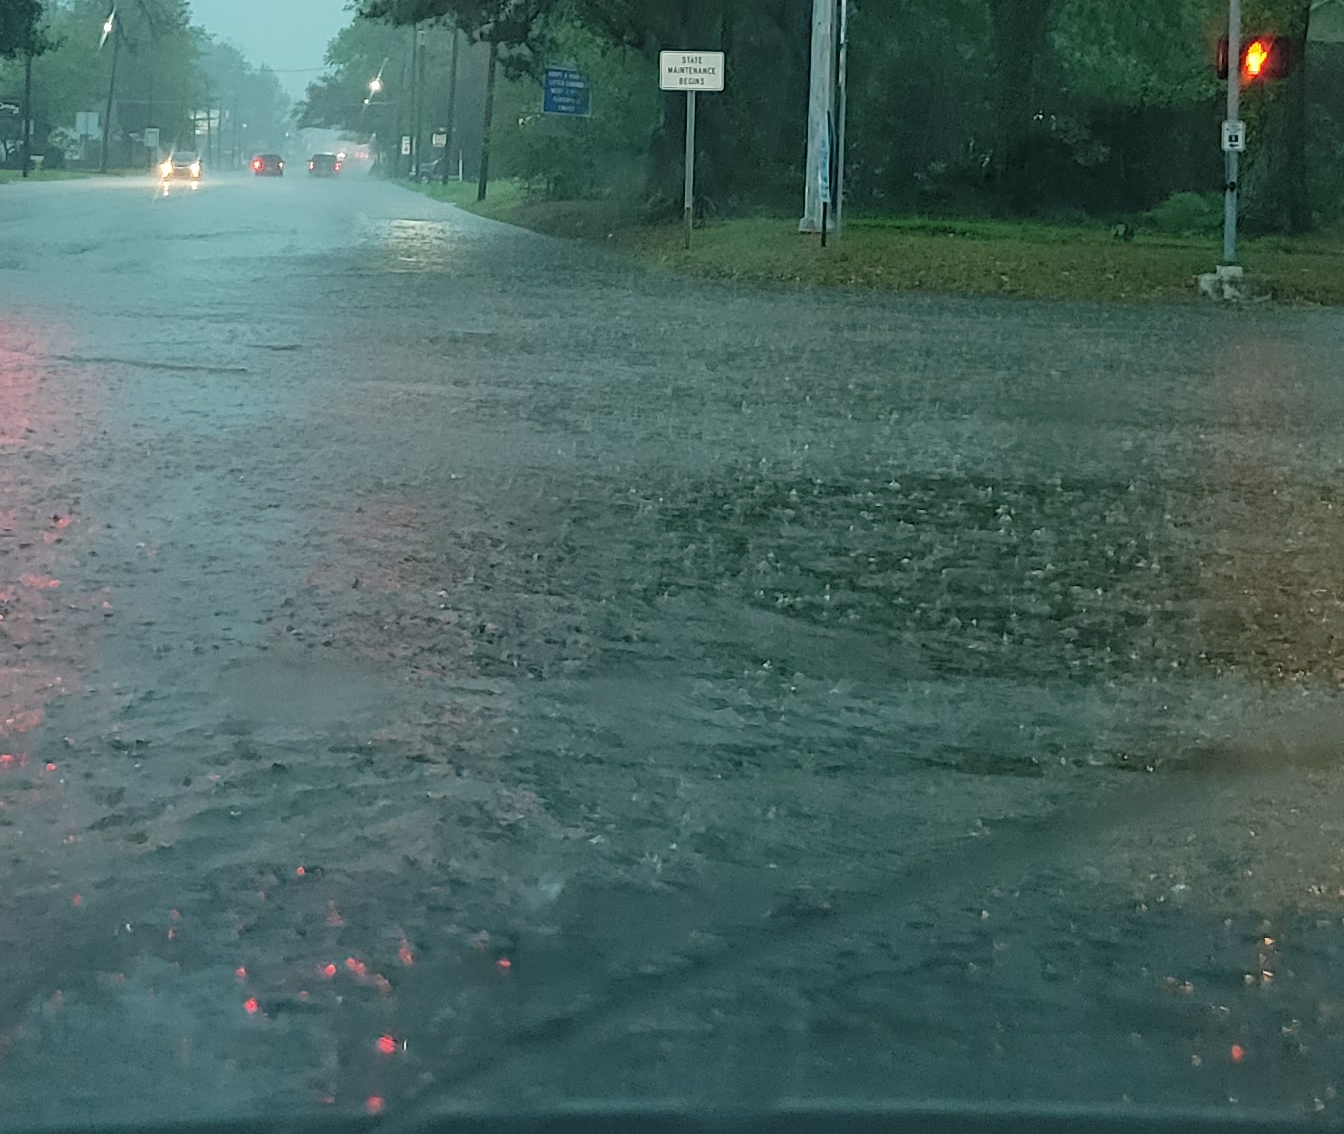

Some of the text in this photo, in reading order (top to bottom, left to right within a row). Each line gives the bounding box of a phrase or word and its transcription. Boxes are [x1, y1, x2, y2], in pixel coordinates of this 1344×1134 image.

[681, 56, 703, 64] STATE
[667, 66, 717, 75] MAINTENANCE
[678, 77, 705, 86] BEGINS
